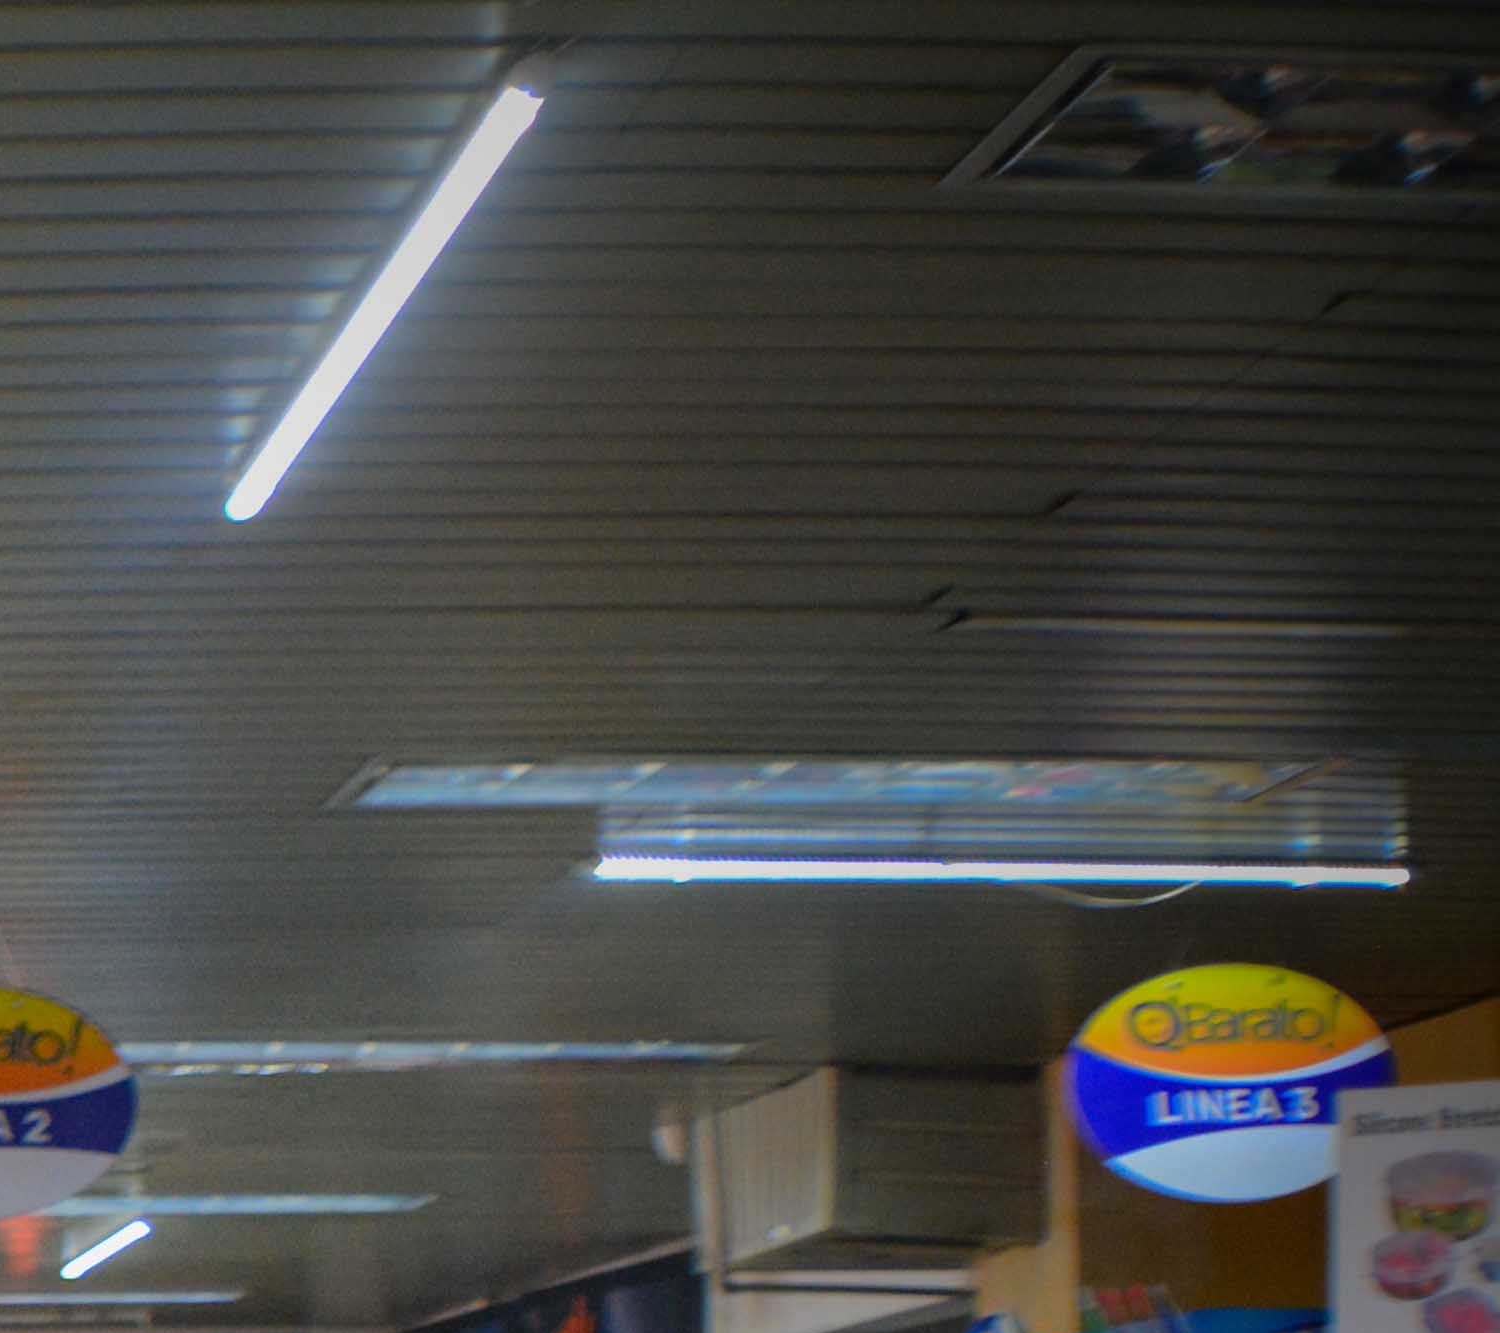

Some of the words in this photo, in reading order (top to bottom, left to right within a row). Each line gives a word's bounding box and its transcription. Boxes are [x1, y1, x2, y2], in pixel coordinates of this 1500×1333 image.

[1145, 1088, 1284, 1127] LINEA
[1286, 1087, 1320, 1120] 3
[22, 1109, 53, 1142] 2
